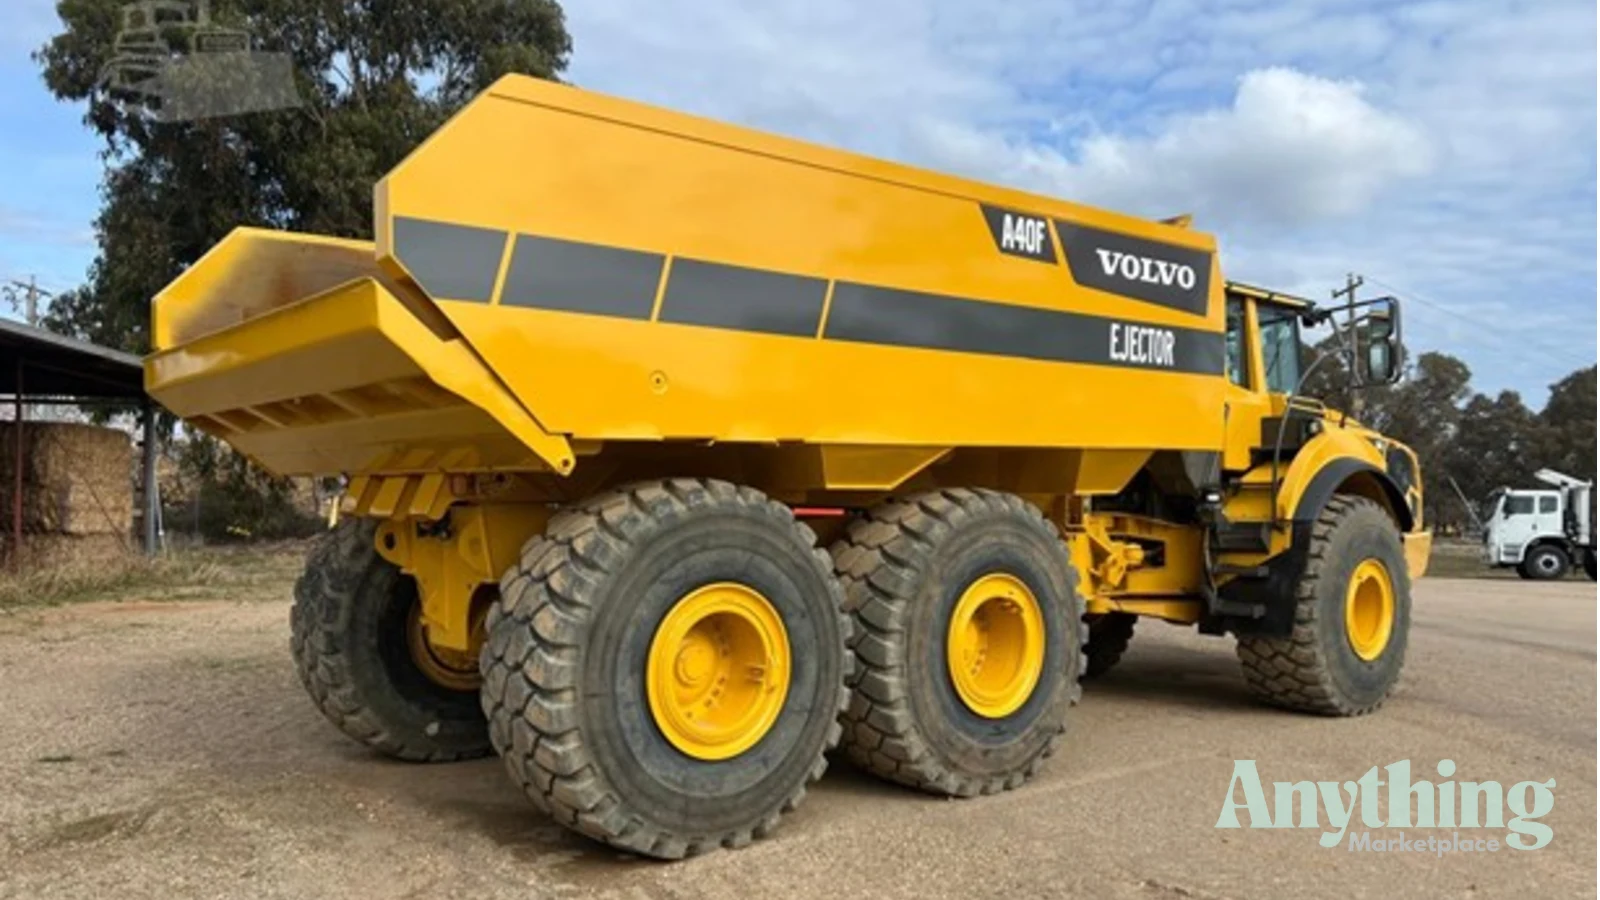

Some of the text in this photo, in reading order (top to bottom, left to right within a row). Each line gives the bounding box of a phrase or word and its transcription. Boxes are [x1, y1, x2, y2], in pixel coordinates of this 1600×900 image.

[1001, 213, 1046, 253] A40F
[1096, 248, 1195, 290] VOLVO
[1109, 323, 1175, 366] EJECTOR
